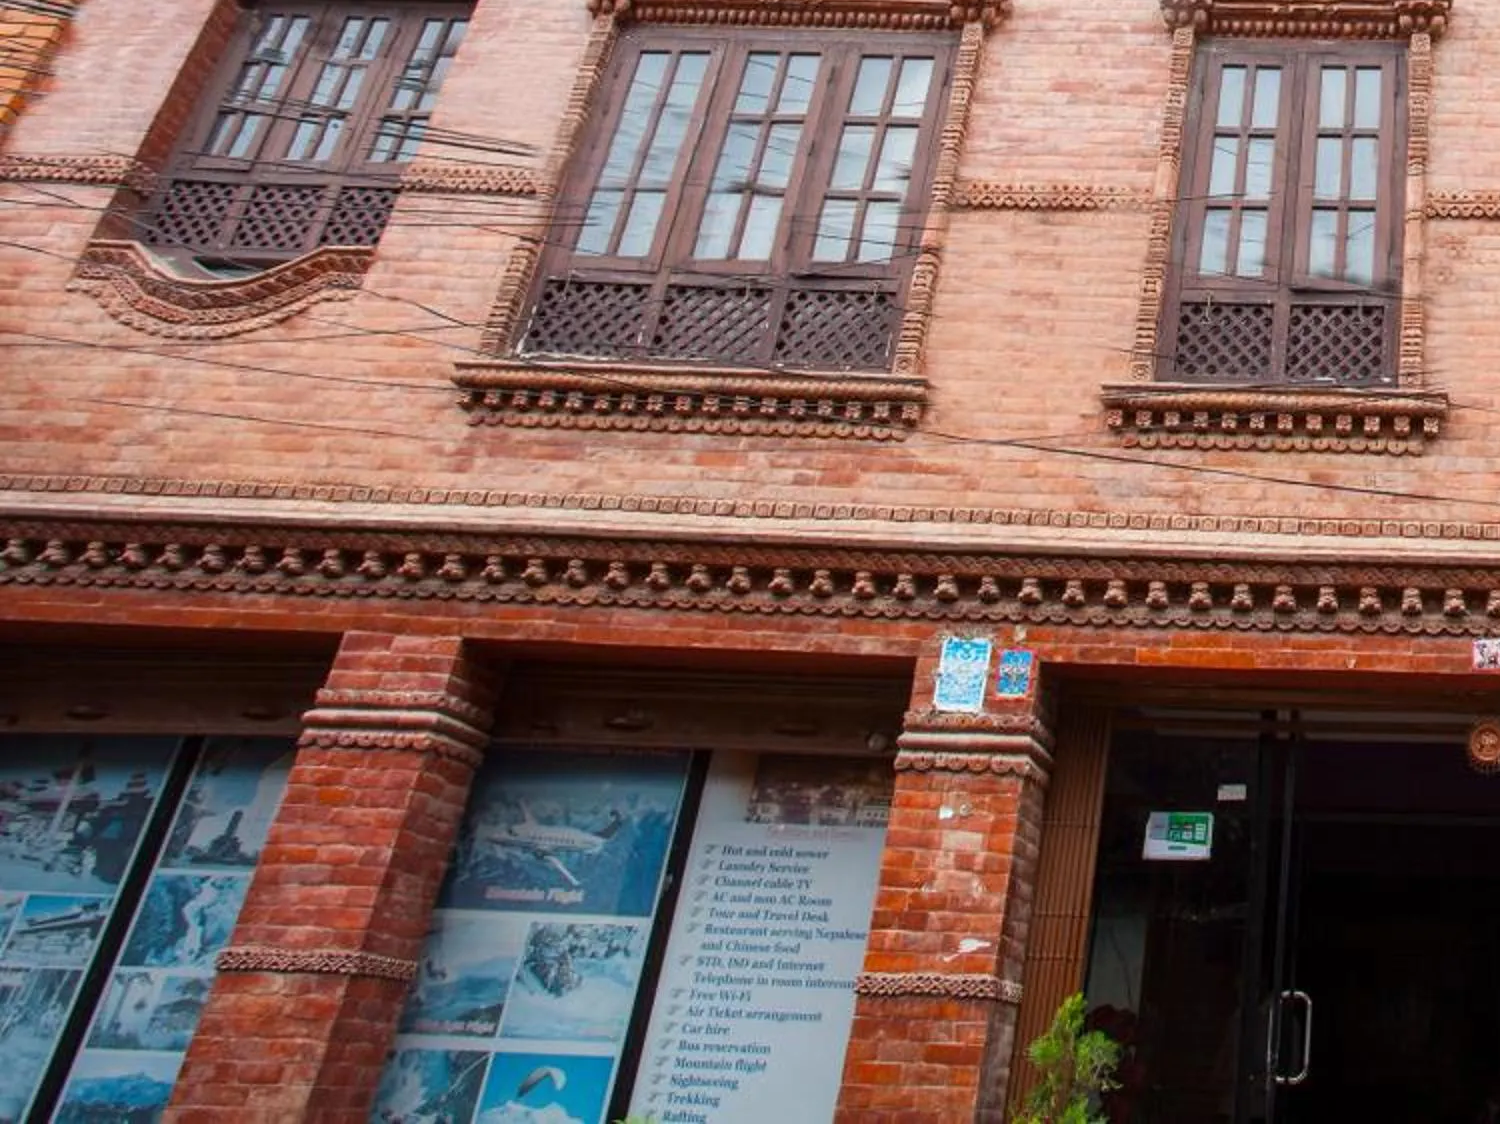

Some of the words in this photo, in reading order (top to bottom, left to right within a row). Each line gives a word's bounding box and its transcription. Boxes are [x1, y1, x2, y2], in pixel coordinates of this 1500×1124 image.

[721, 845, 743, 857] Hot
[744, 846, 767, 857] and
[768, 847, 793, 858] cold
[719, 860, 766, 873] Laundry
[768, 863, 811, 874] Service
[714, 875, 762, 888] Channel
[763, 878, 794, 889] cable
[796, 879, 812, 889] TV
[713, 891, 729, 902] AC
[730, 893, 753, 904] and
[779, 894, 797, 905] AC
[798, 895, 833, 906] Room
[708, 908, 736, 919] Tour
[737, 909, 760, 920] and
[762, 909, 799, 921] Travel
[801, 911, 829, 922] Desk
[770, 928, 813, 940] serving
[702, 941, 723, 951] and
[725, 941, 771, 952] Chinese
[773, 942, 800, 954] food
[751, 958, 774, 969] and
[776, 959, 825, 971] Internet
[693, 971, 754, 986] Telephone
[756, 974, 768, 986] in
[770, 977, 802, 988] room
[689, 989, 717, 1001] Free
[719, 989, 751, 1002] Wi-Fi
[686, 1006, 704, 1017] Air
[707, 1006, 743, 1018] Ticket
[745, 1010, 823, 1023] arrangement
[681, 1024, 701, 1035] Car
[704, 1024, 730, 1035] hire
[677, 1039, 700, 1051] Bus
[702, 1041, 771, 1055] reservation
[674, 1057, 732, 1071] Mountain
[734, 1059, 767, 1074] flight
[666, 1092, 721, 1108] Trekking
[662, 1111, 707, 1124] Rafting
